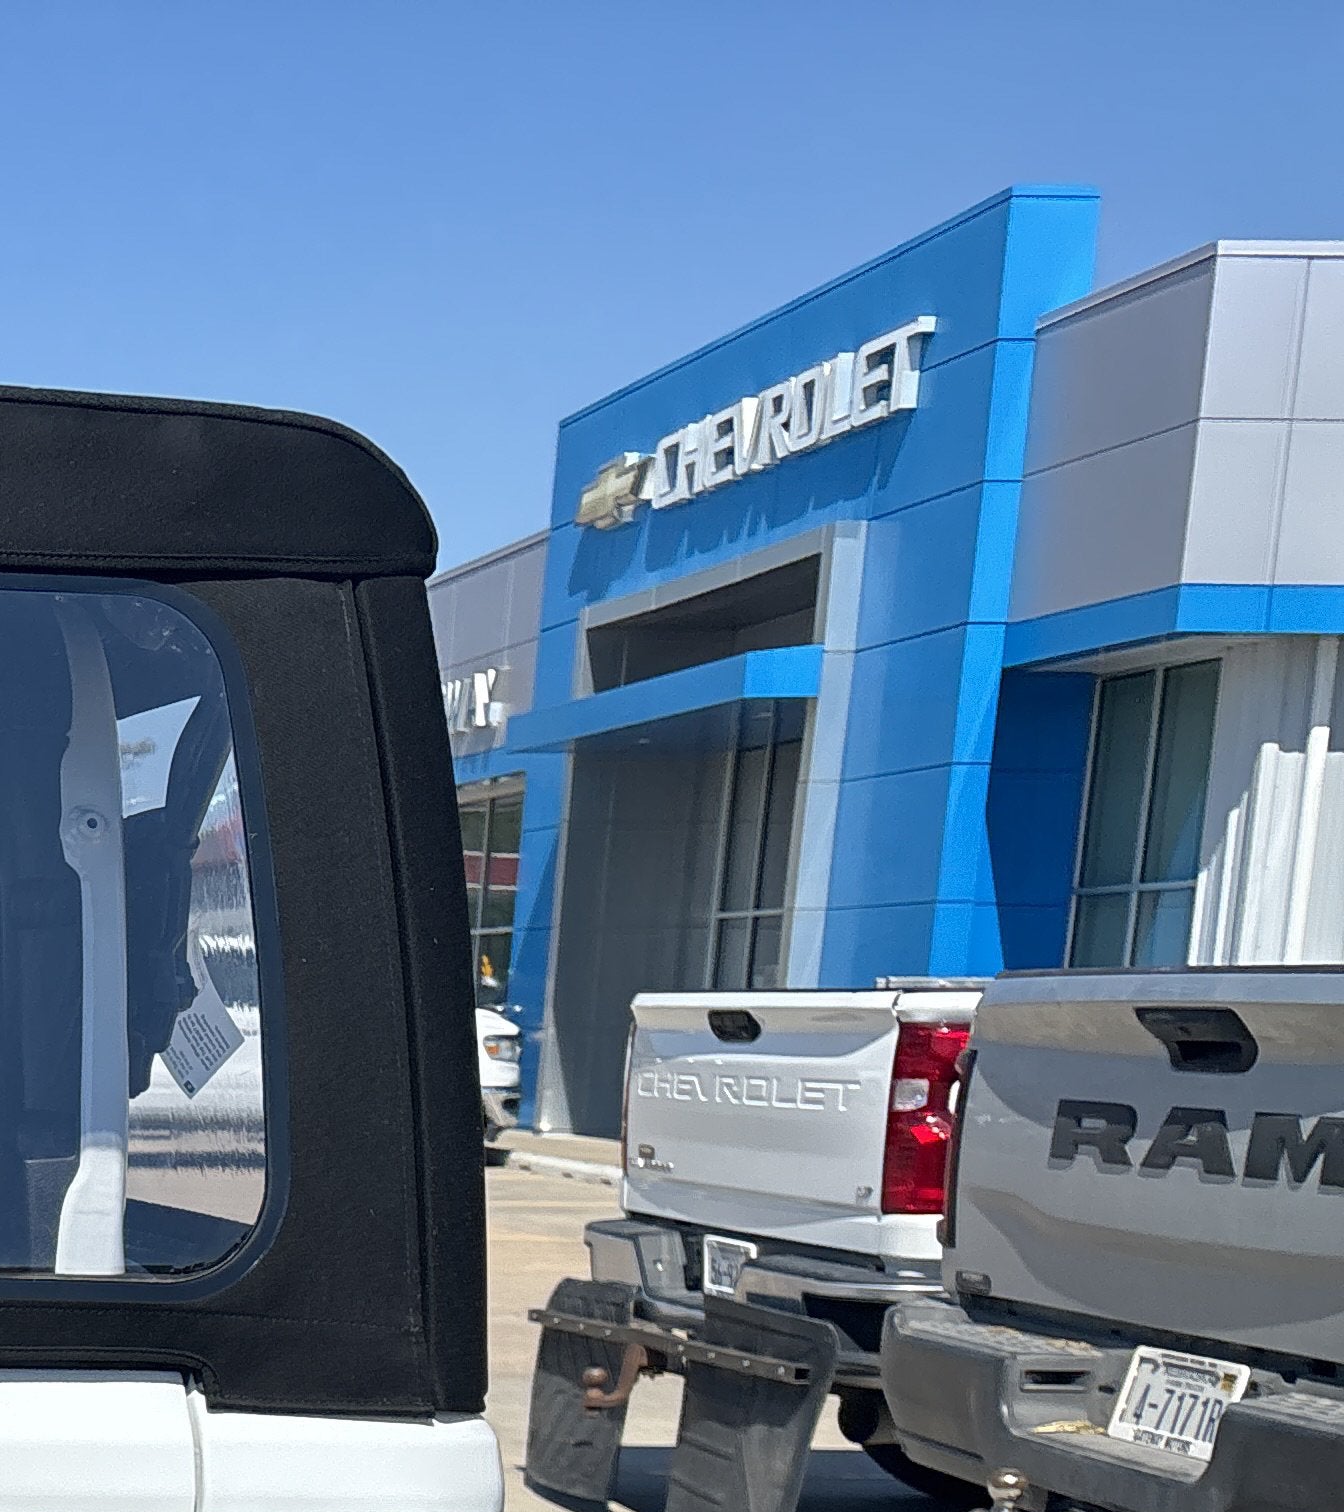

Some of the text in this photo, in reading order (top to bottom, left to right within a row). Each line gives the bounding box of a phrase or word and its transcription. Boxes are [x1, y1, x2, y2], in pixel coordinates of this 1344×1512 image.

[649, 315, 937, 510] CHEVROLET
[637, 1070, 862, 1112] CHEVROLET
[1047, 1098, 1344, 1188] RAM
